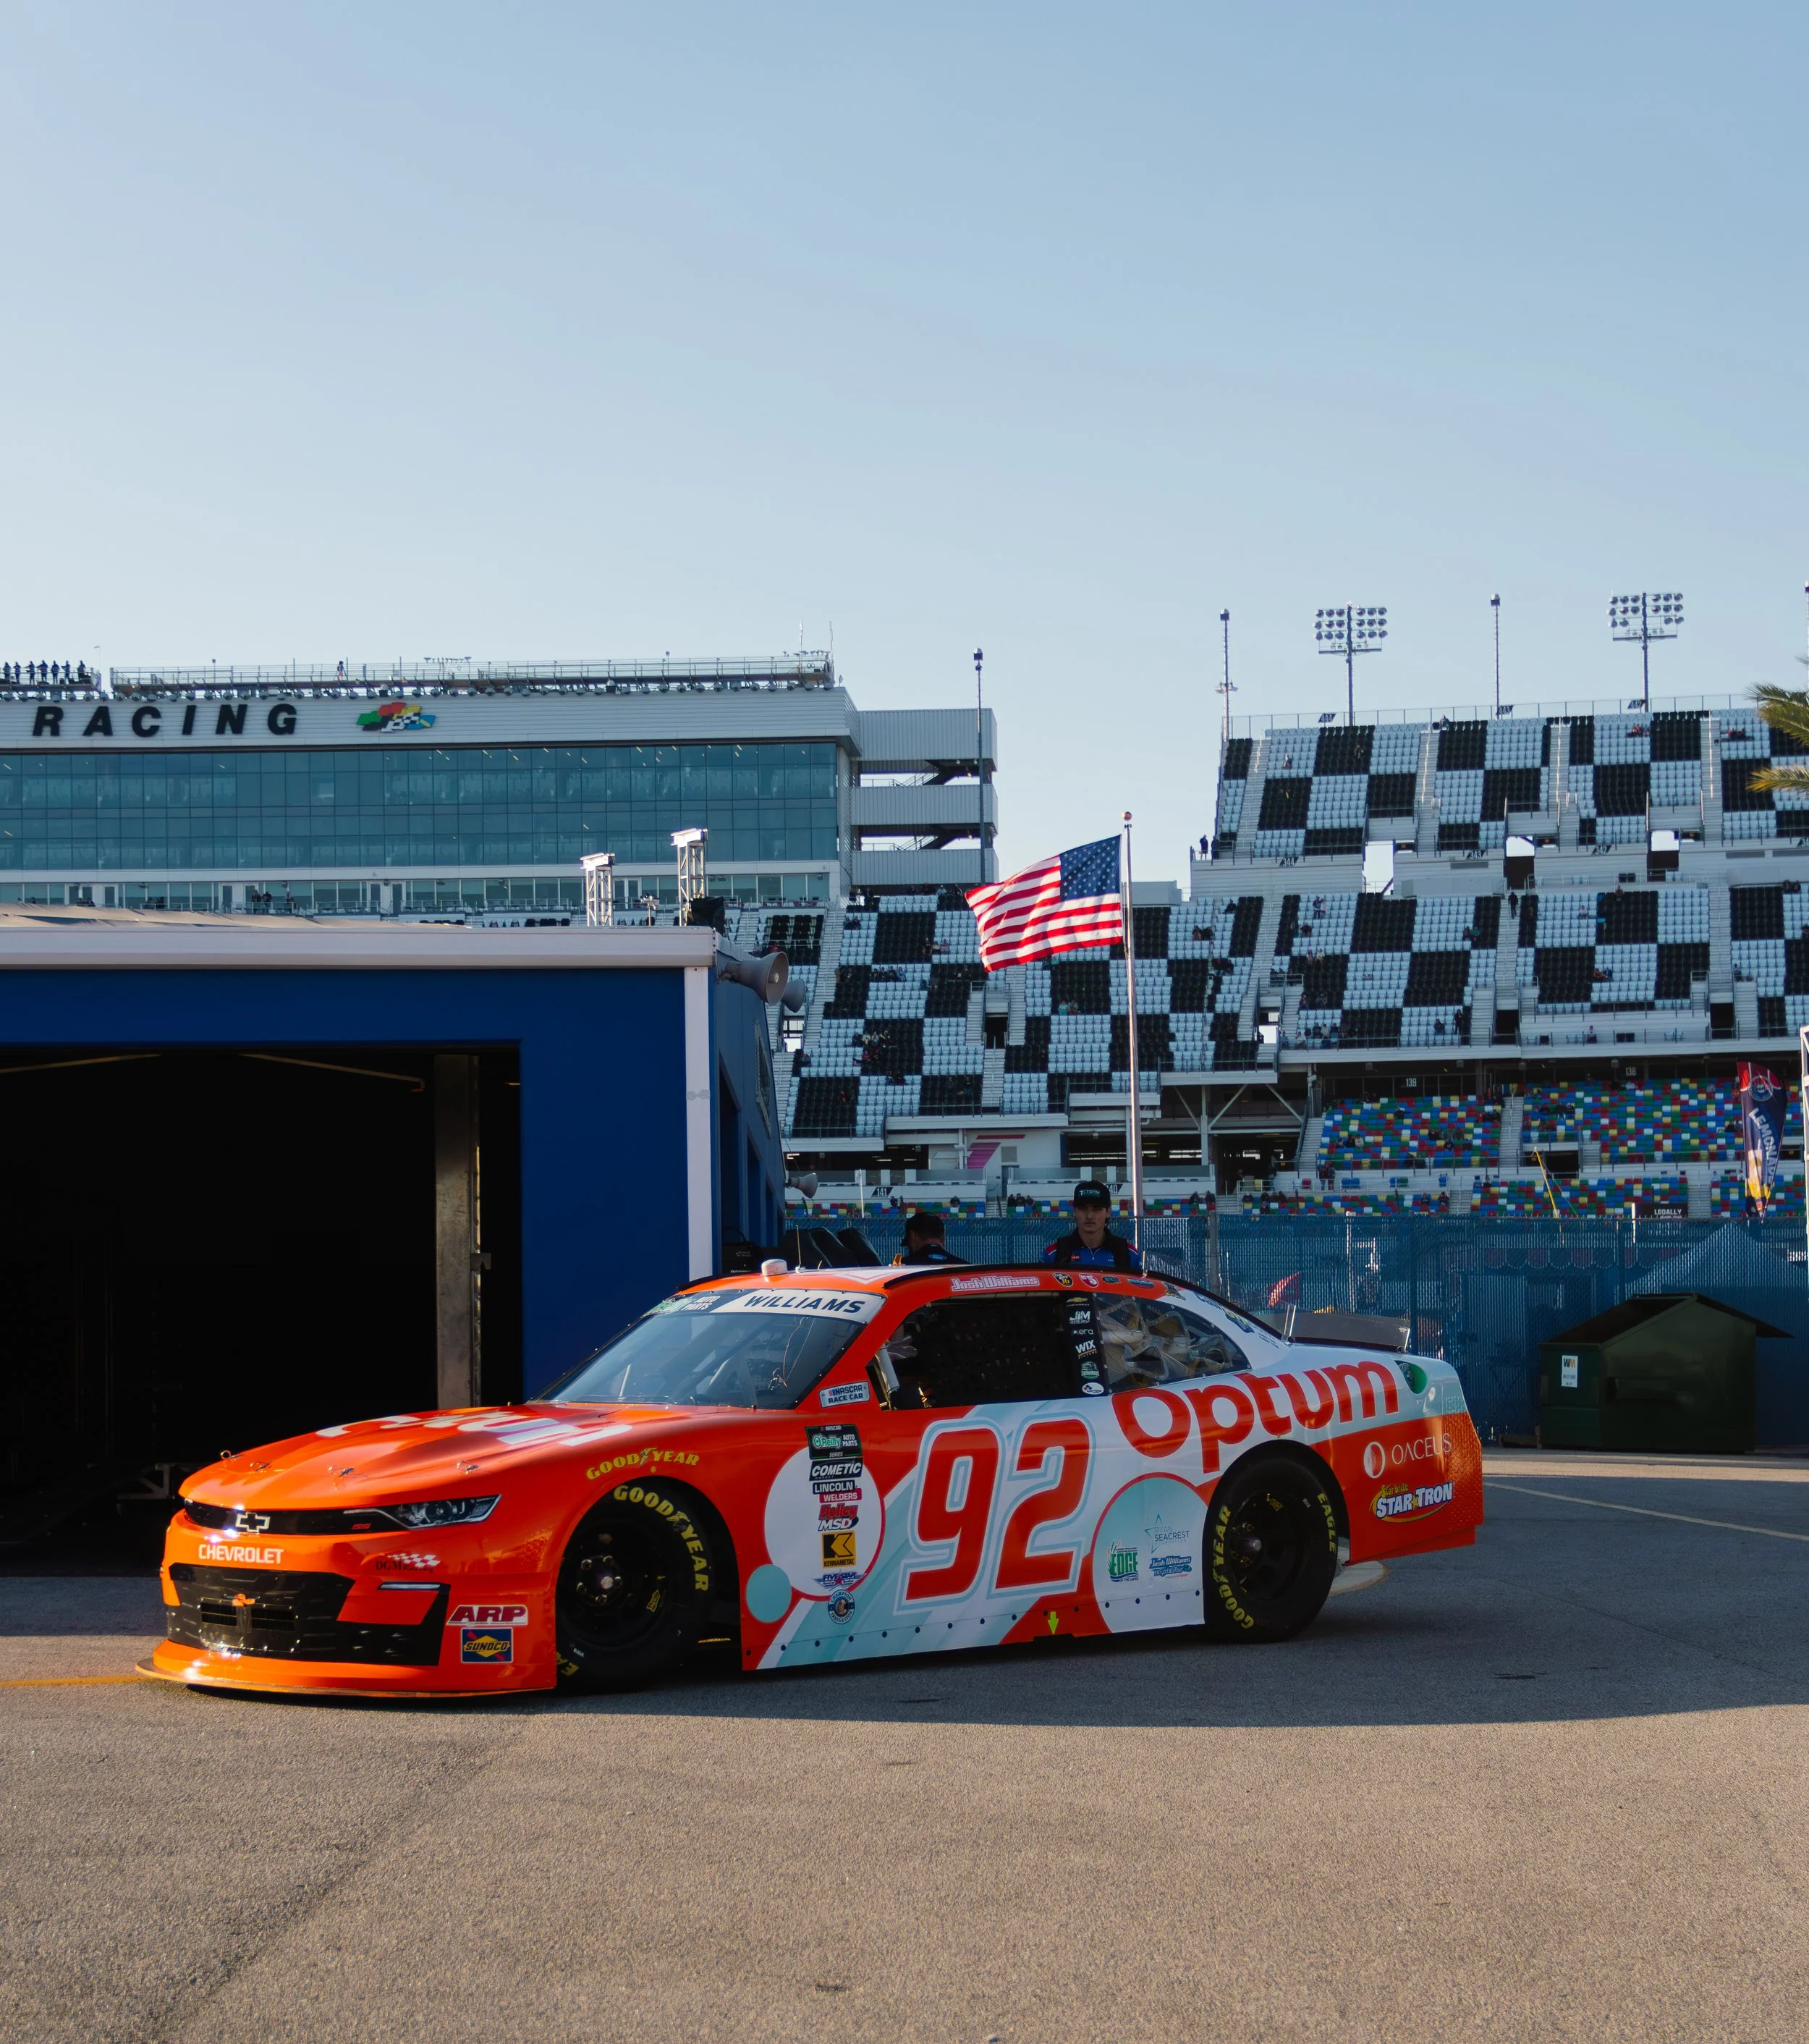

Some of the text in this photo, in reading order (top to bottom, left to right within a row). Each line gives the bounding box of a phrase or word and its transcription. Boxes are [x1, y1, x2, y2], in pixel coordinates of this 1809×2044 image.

[33, 704, 297, 738] RACING
[1625, 1066, 1637, 1076] 138
[1405, 1077, 1417, 1087] 139
[876, 1187, 888, 1197] 141
[952, 1278, 983, 1291] Josh
[983, 1276, 1039, 1288] Williams
[743, 1296, 866, 1314] WILLIAMS
[1075, 1339, 1096, 1353] WIX
[834, 1385, 863, 1395] NASCAR
[828, 1395, 847, 1403] RACE
[1111, 1361, 1399, 1474] optum
[813, 1435, 842, 1448] O'Reilly
[586, 1448, 700, 1479] GOODYEAR
[811, 1462, 862, 1477] COMETIC
[814, 1481, 853, 1493] LINCOLN
[823, 1492, 858, 1502] WELDERS
[819, 1503, 858, 1520] Holley
[902, 1415, 1093, 1606] 92
[818, 1518, 855, 1532] MSD
[1317, 1492, 1337, 1552] EAGLE
[614, 1485, 709, 1592] GOODYEAR
[1154, 1530, 1189, 1542] SEACREST
[198, 1544, 284, 1564] CHEVROLET
[376, 1560, 402, 1571] DGM
[823, 1558, 855, 1567] KENNAMETAL
[1109, 1552, 1138, 1576] EDGE
[1213, 1505, 1254, 1629] GOODYEAR
[831, 1591, 852, 1603] CHAMPION
[449, 1605, 528, 1622] ARP
[465, 1642, 508, 1652] SUNOCO
